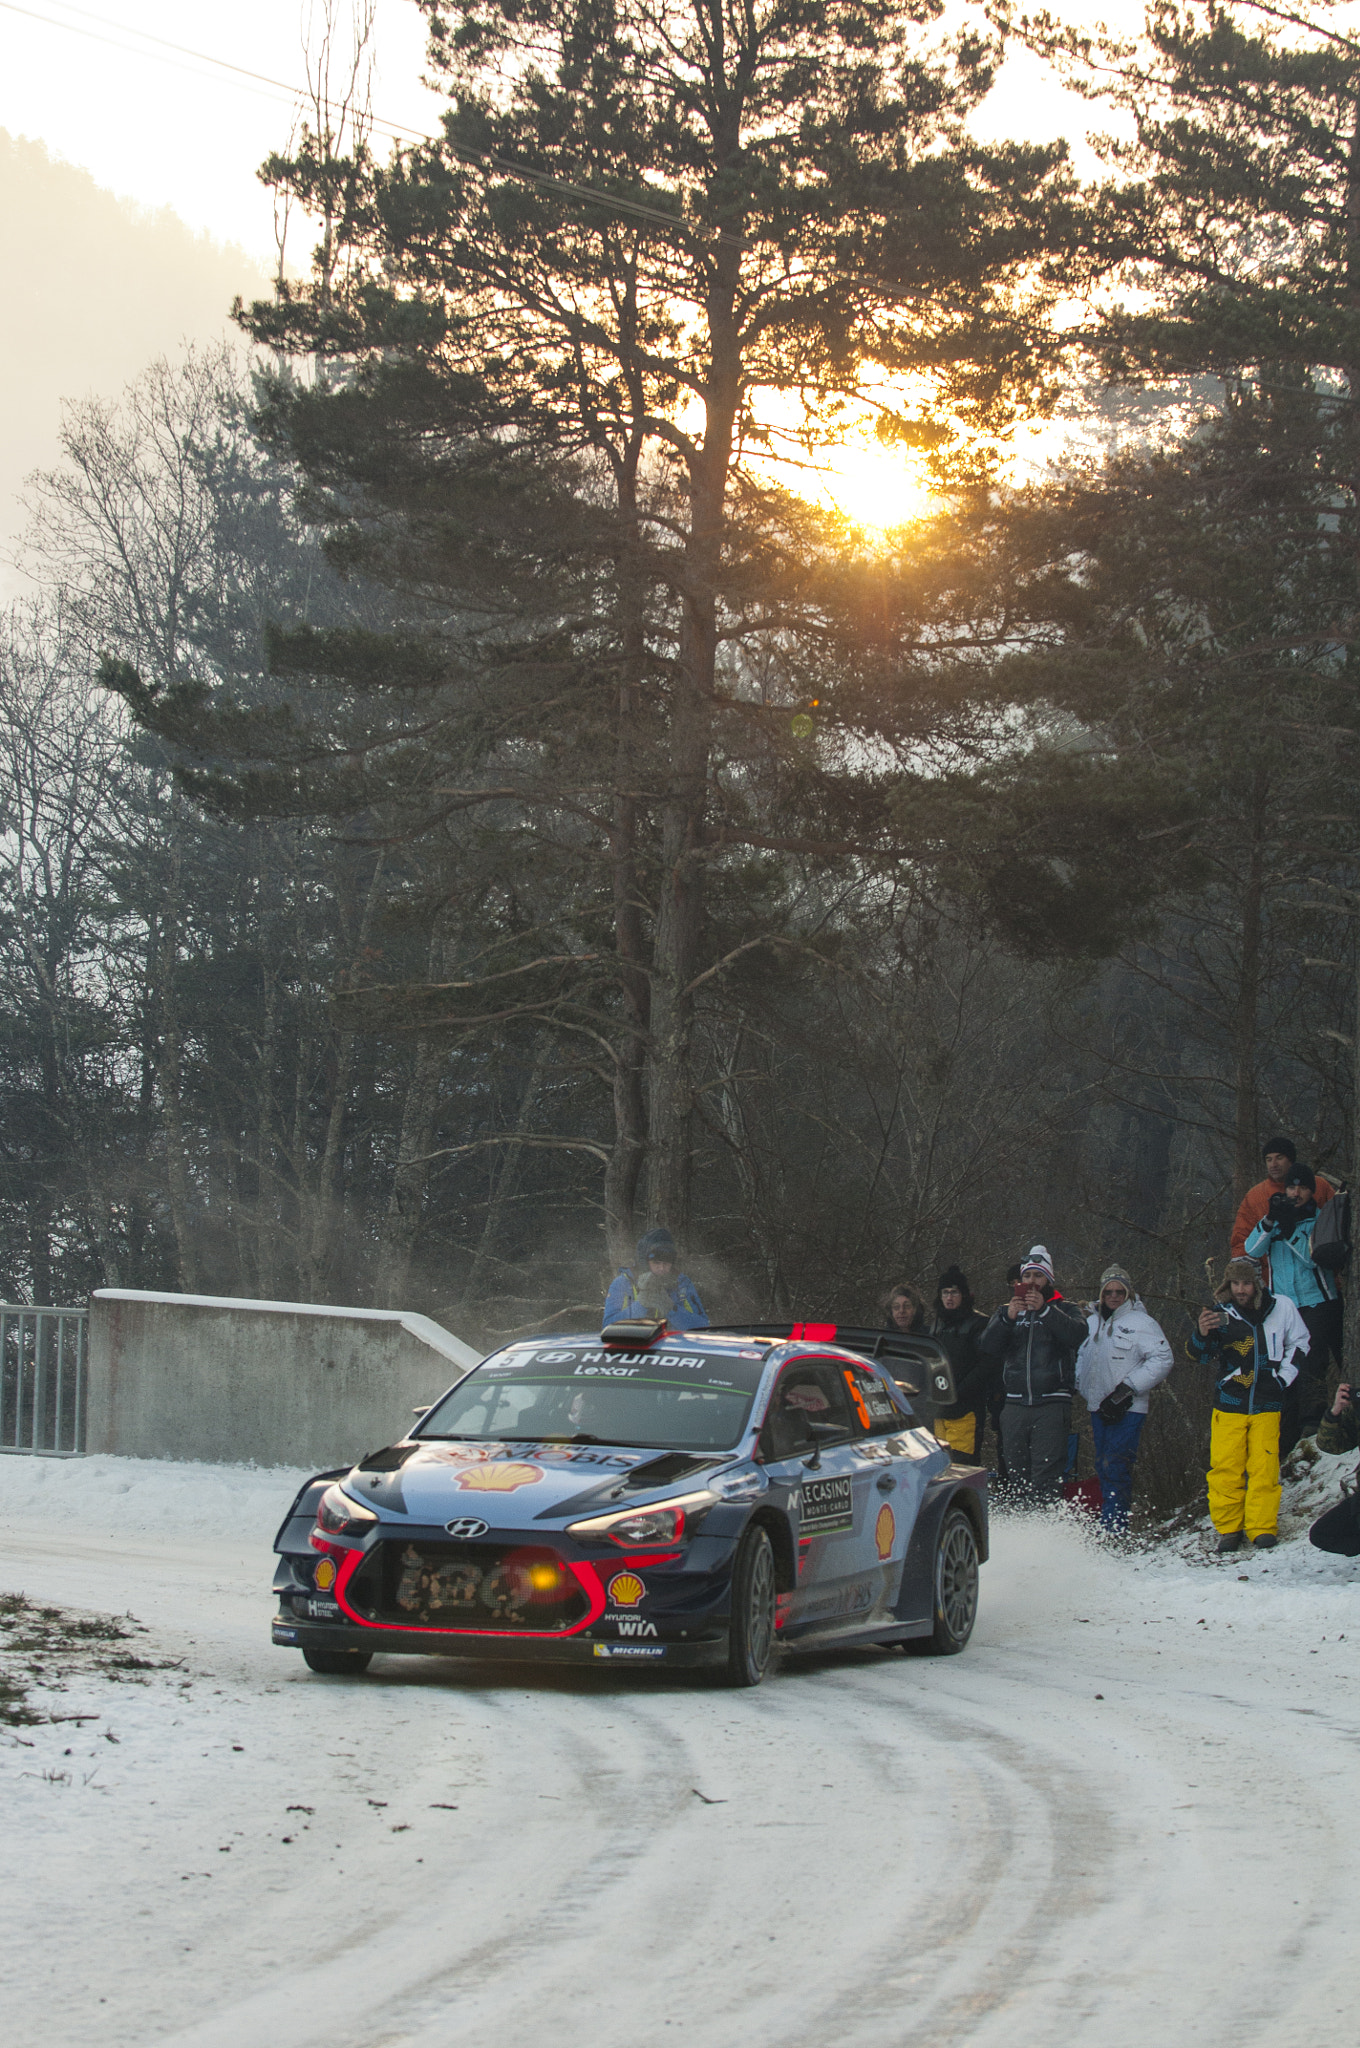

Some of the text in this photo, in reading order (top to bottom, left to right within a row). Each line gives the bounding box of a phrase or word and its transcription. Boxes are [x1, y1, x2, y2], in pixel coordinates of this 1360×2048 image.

[500, 1353, 519, 1367] 5
[580, 1352, 706, 1369] HYUNDAI
[574, 1365, 640, 1377] Lexar
[843, 1370, 871, 1430] 5
[493, 1449, 642, 1468] MOBIS
[604, 1614, 642, 1622] HYUNDAI
[618, 1620, 658, 1637] WIA
[612, 1647, 664, 1656] MICHELIN
